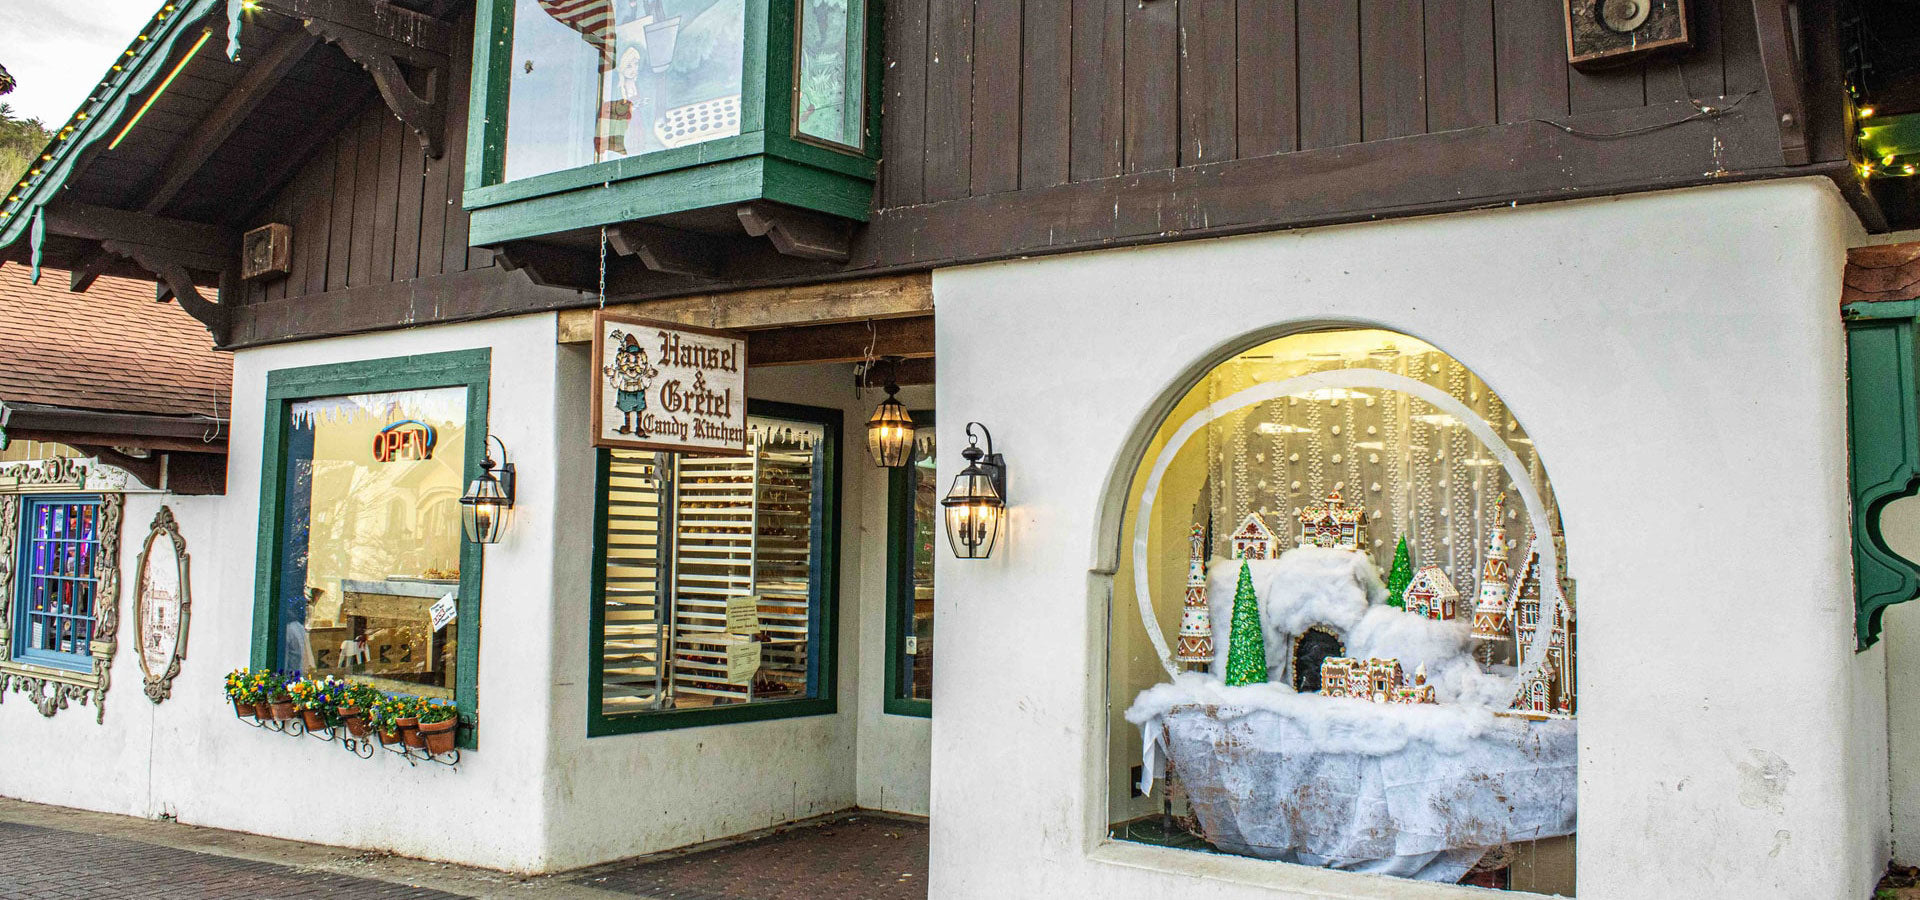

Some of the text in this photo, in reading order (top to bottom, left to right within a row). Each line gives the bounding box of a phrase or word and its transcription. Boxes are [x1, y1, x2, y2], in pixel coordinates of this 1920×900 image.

[657, 330, 738, 373] Hansel
[692, 370, 706, 391] &
[660, 379, 732, 419] Gretel
[372, 428, 427, 462] OPEN
[643, 413, 743, 446] Candy Kitchen
